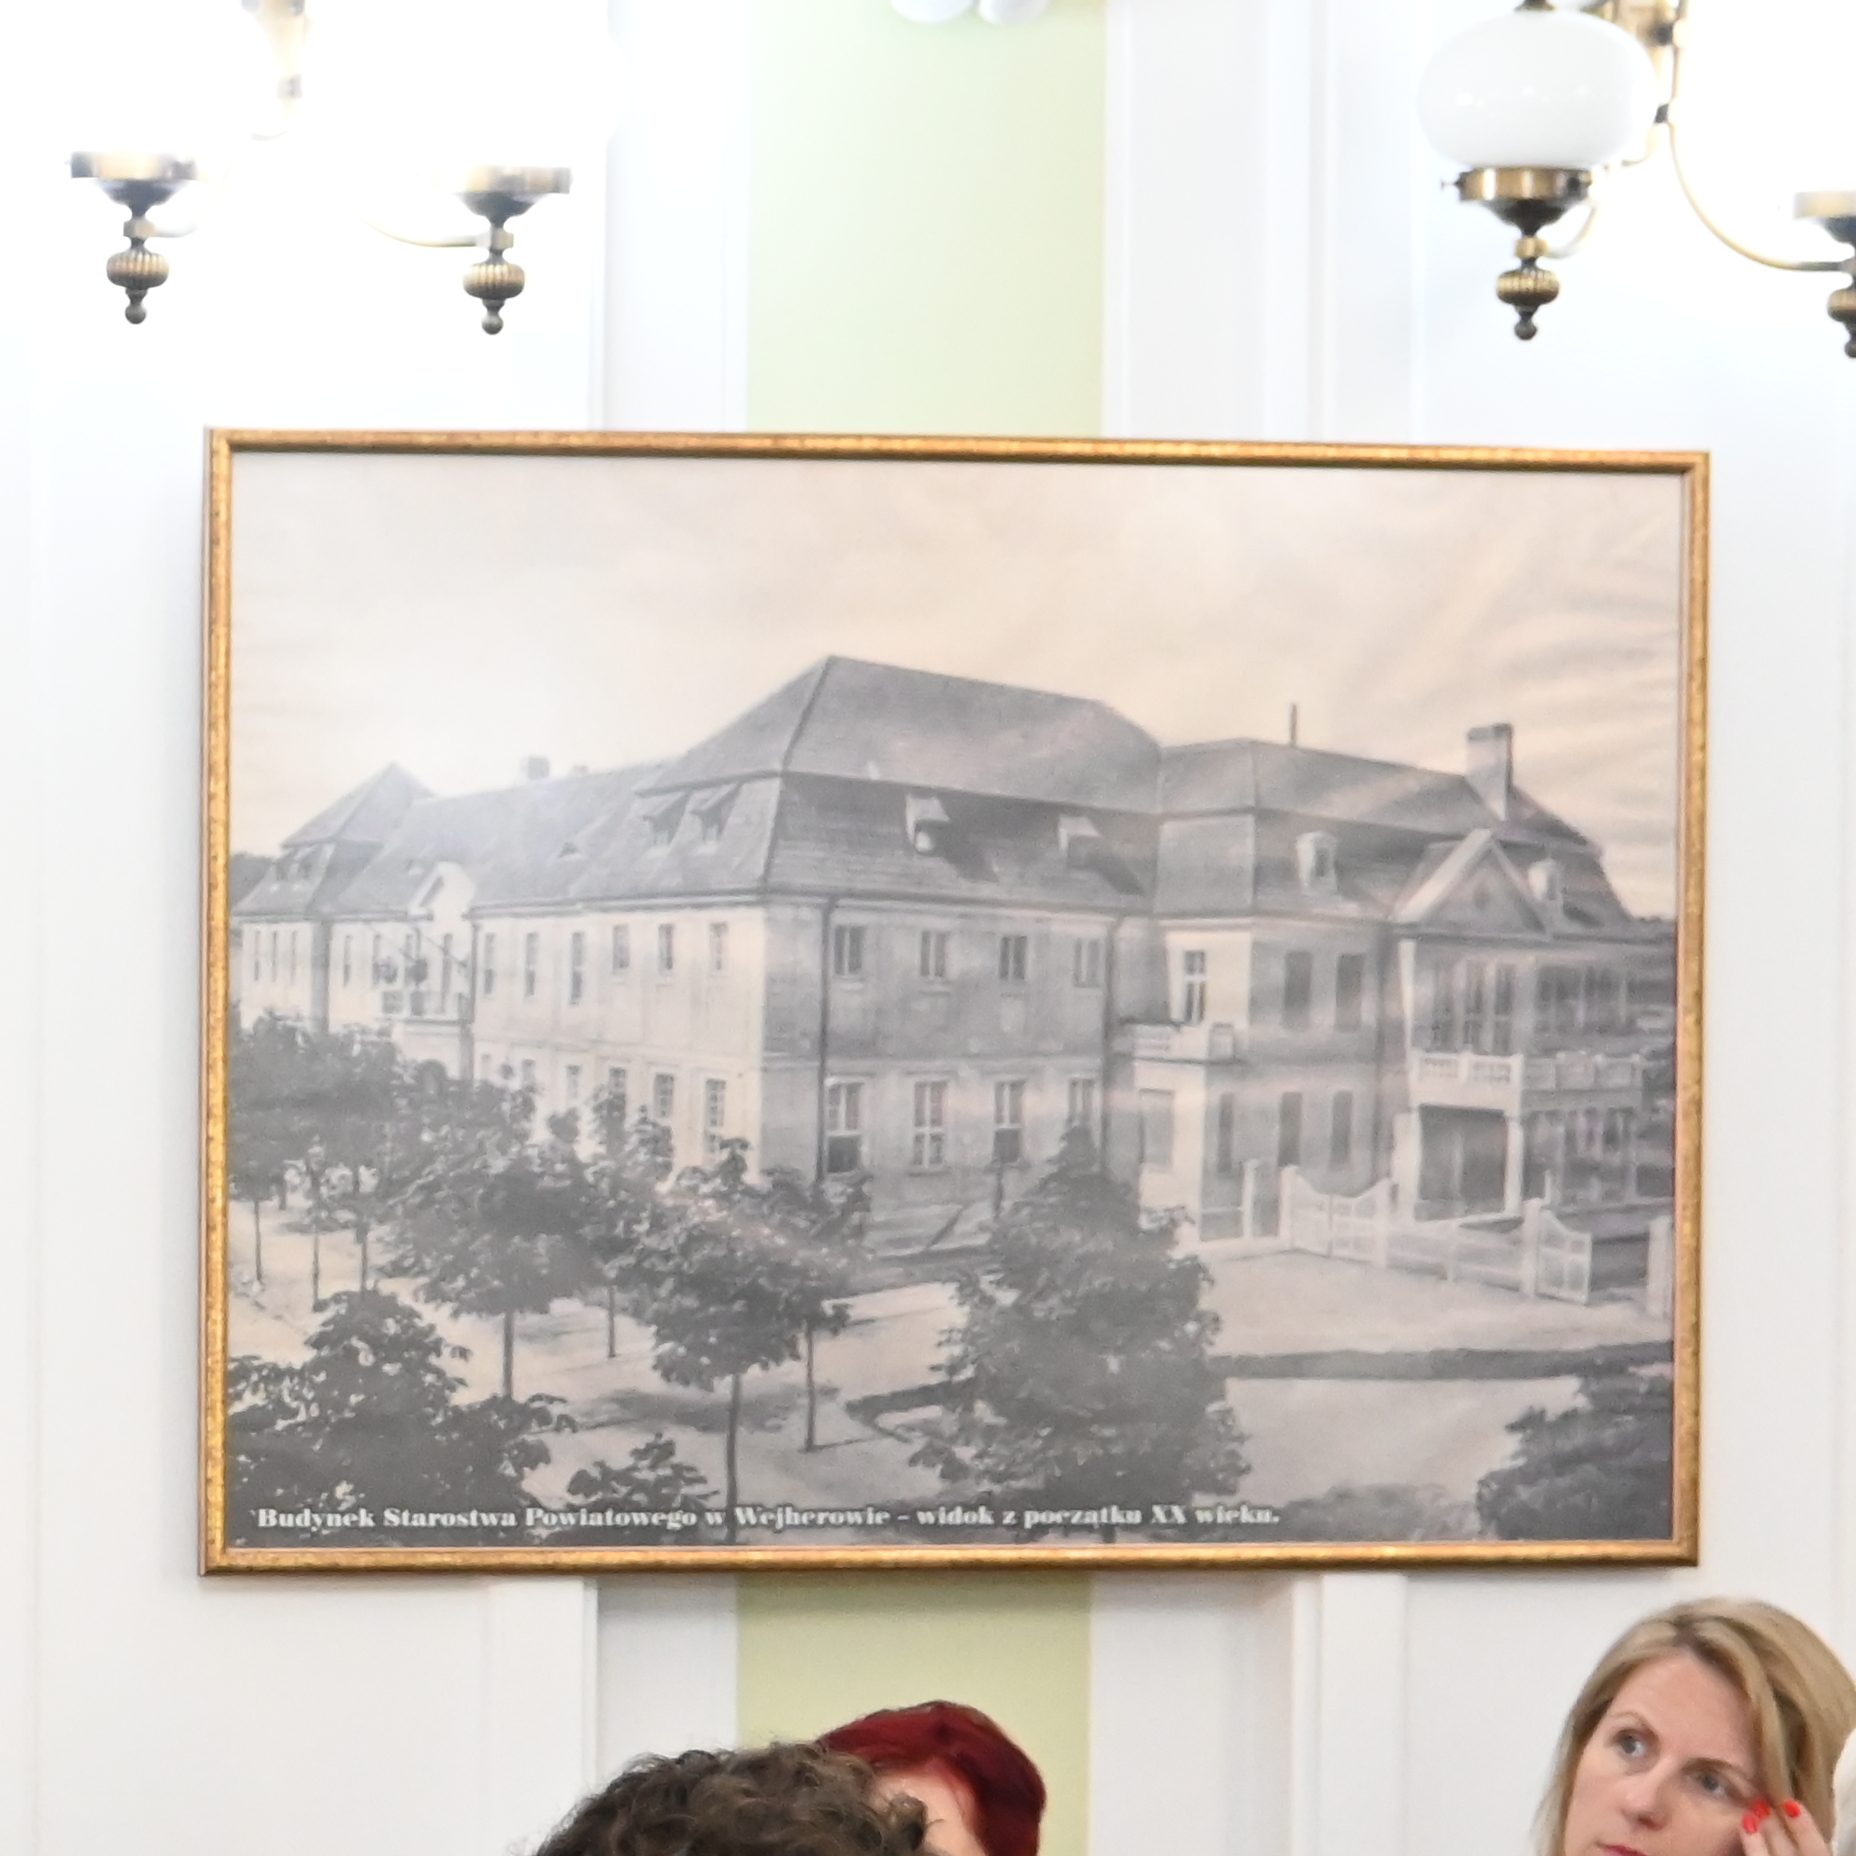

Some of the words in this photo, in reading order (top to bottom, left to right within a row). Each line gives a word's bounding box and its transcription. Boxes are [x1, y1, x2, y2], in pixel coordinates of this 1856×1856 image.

[257, 1507, 375, 1532] Budynek
[382, 1507, 518, 1528] Starostwa
[525, 1507, 698, 1531] Powiatowego
[704, 1510, 727, 1526] w
[734, 1506, 891, 1530] Wejherowie
[915, 1505, 995, 1525] widok
[1002, 1510, 1017, 1525] z
[1023, 1504, 1142, 1529] początku
[1150, 1504, 1188, 1525] XX
[1194, 1504, 1281, 1525] wieku.
